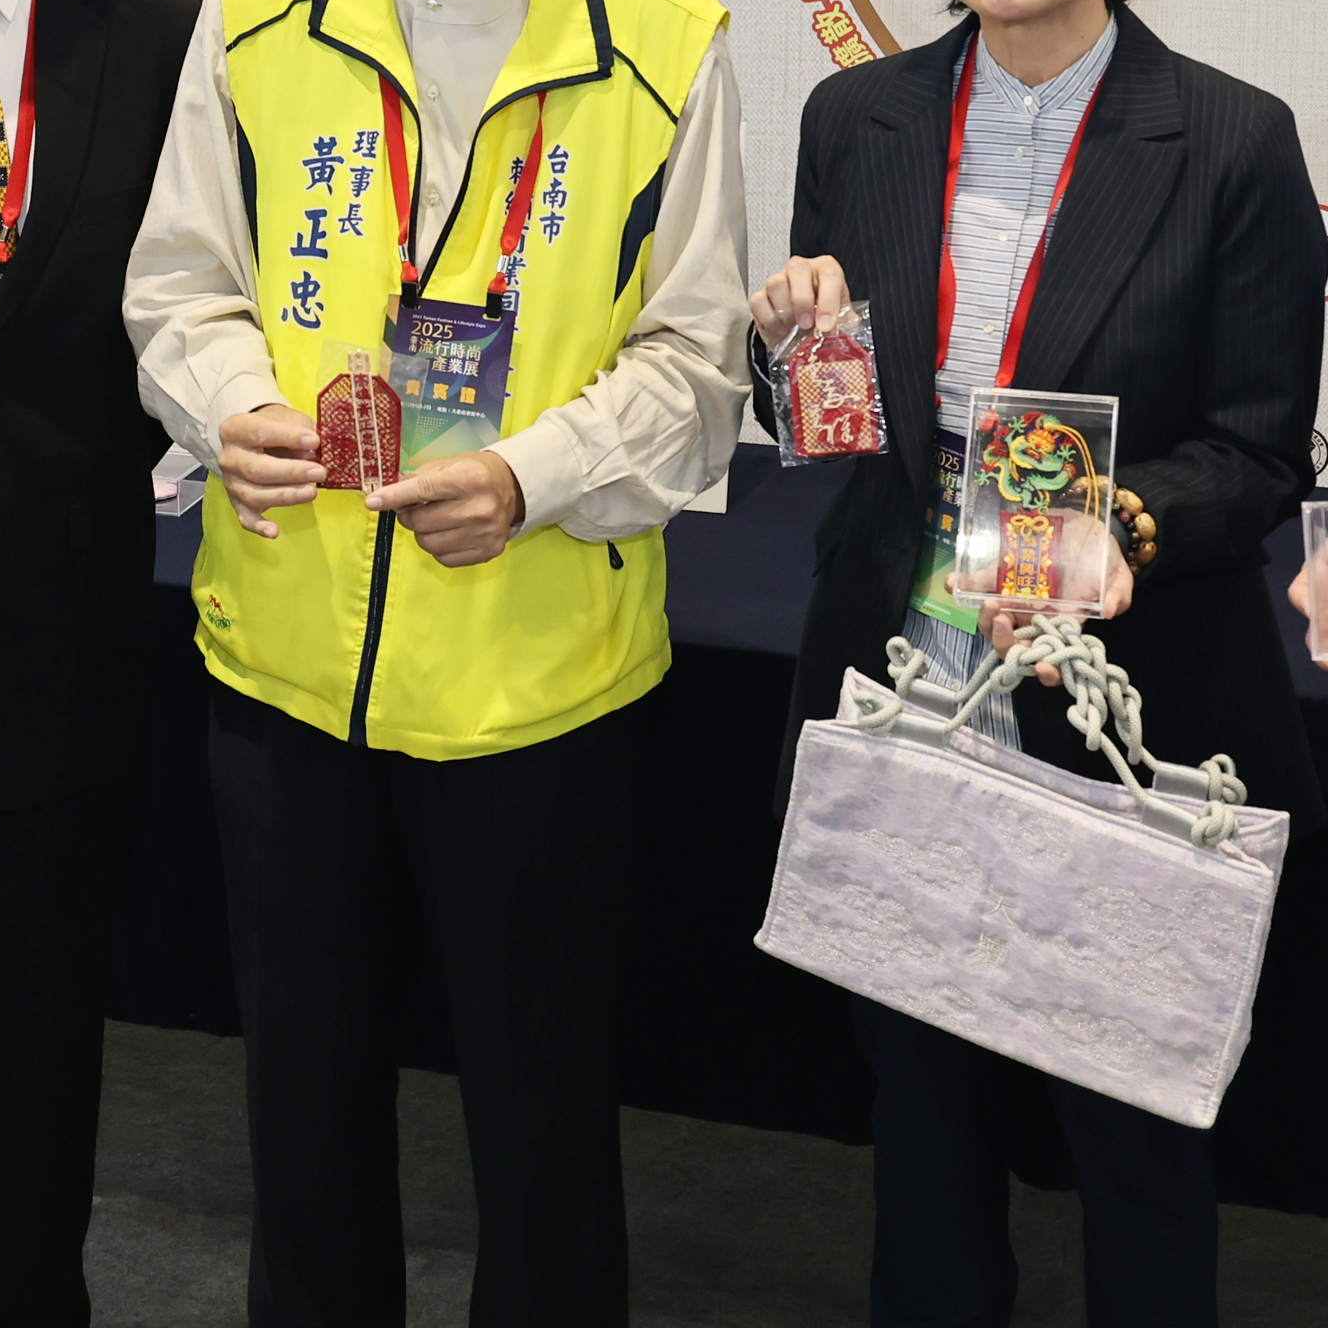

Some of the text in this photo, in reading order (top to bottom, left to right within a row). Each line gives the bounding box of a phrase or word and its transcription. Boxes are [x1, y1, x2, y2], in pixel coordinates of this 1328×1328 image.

[338, 129, 381, 238] 理事長
[538, 143, 571, 245] 台南市
[280, 135, 346, 330] 黃正忠
[411, 321, 453, 339] 2025
[419, 338, 482, 362] 流行時尚
[432, 356, 479, 377] 產業展
